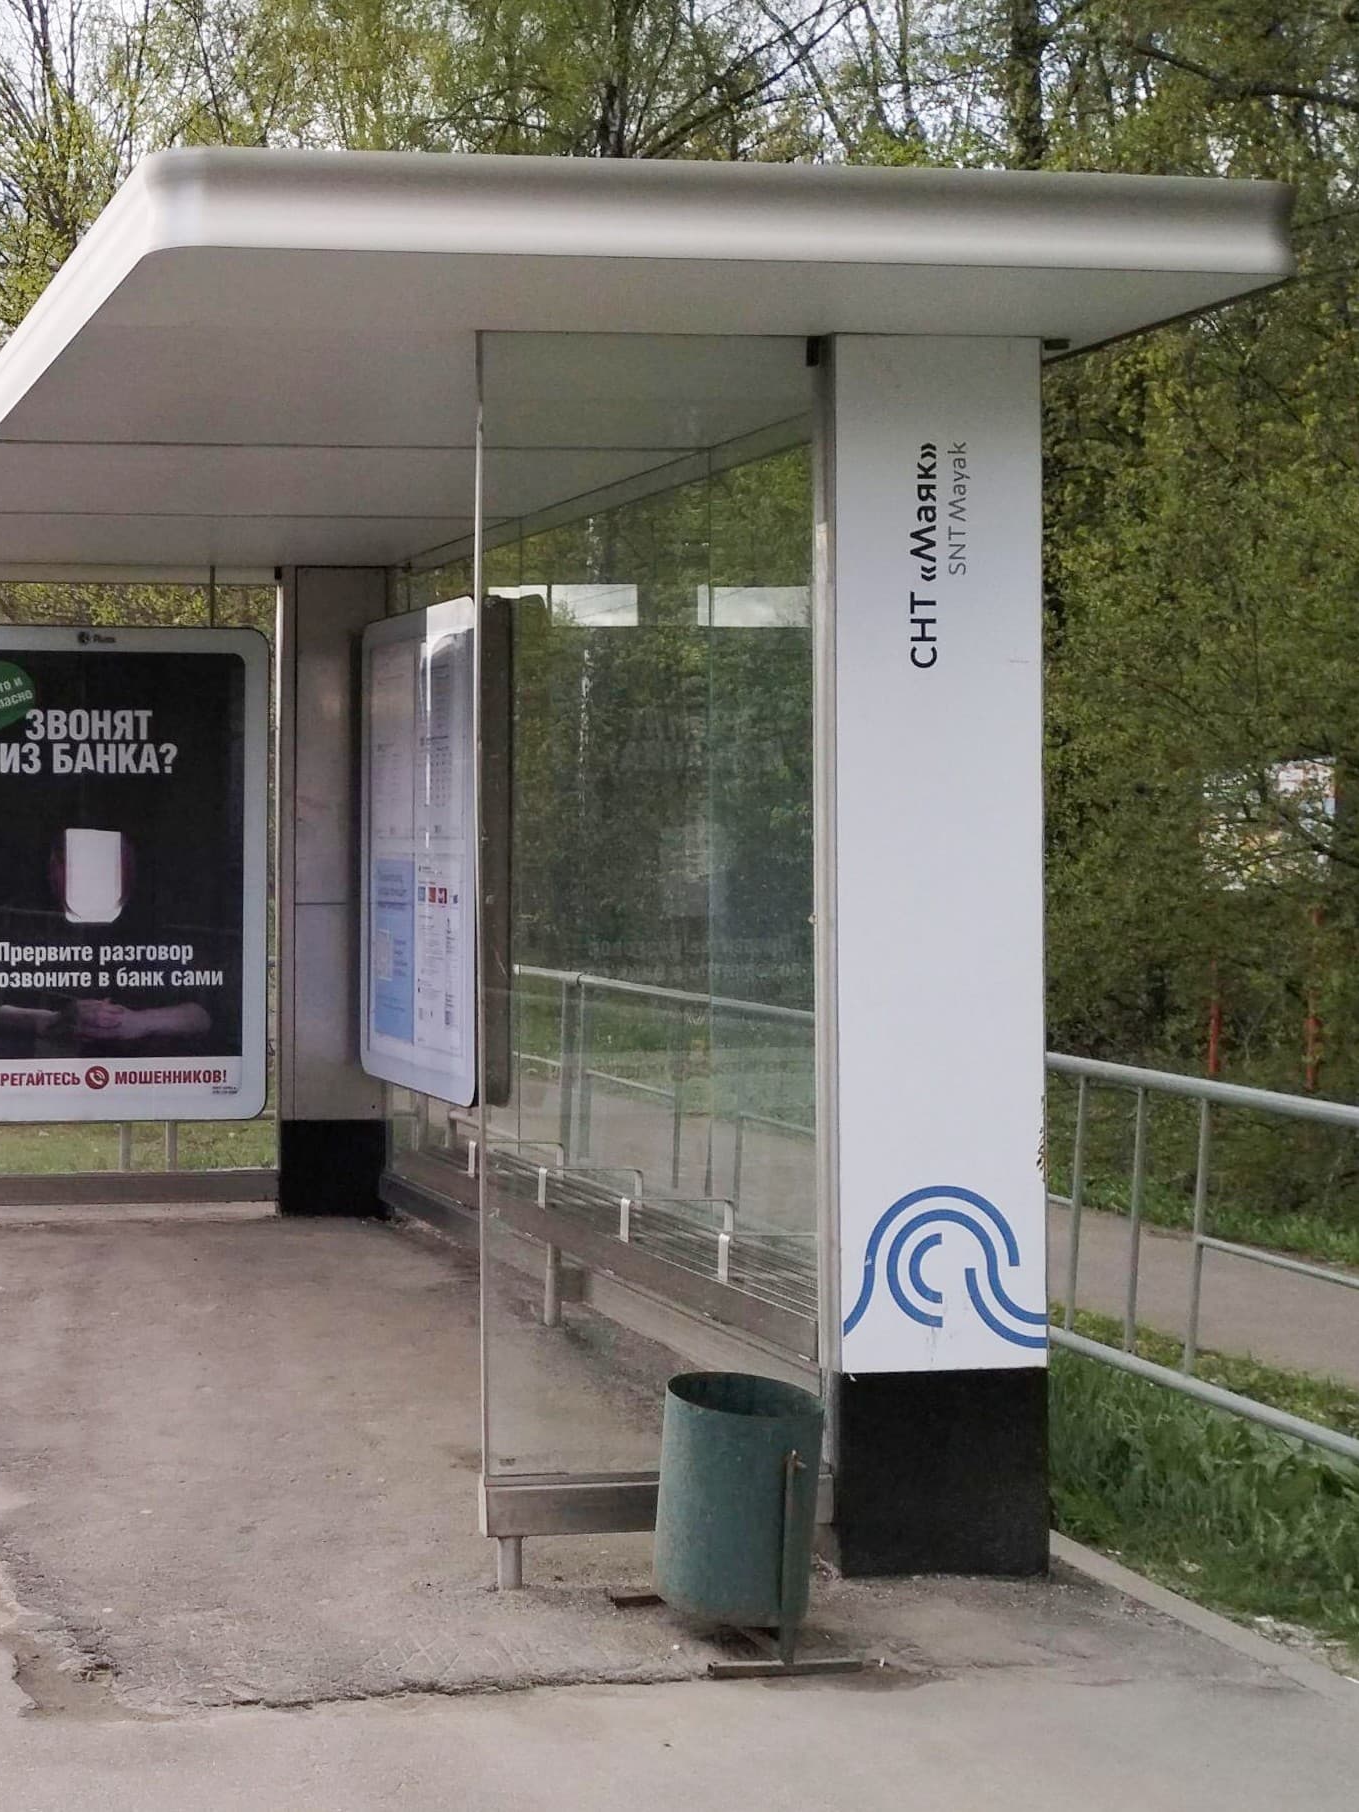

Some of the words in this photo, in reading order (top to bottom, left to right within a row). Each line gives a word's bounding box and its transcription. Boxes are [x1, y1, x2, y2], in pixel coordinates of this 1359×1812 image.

[947, 441, 970, 522] Mayak
[910, 442, 937, 582] «Маяк»
[948, 526, 966, 576] SNT
[910, 591, 937, 669] СНТ
[13, 677, 23, 687] и
[25, 709, 153, 741] ЗВОНЯТ
[0, 743, 41, 774] ИЗ
[52, 743, 178, 774] БАНКА?
[99, 944, 193, 964] разговор
[98, 971, 109, 987] в
[116, 967, 165, 987] банк
[171, 970, 224, 987] сами
[115, 1069, 227, 1085] МОШЕННИКОВ!
